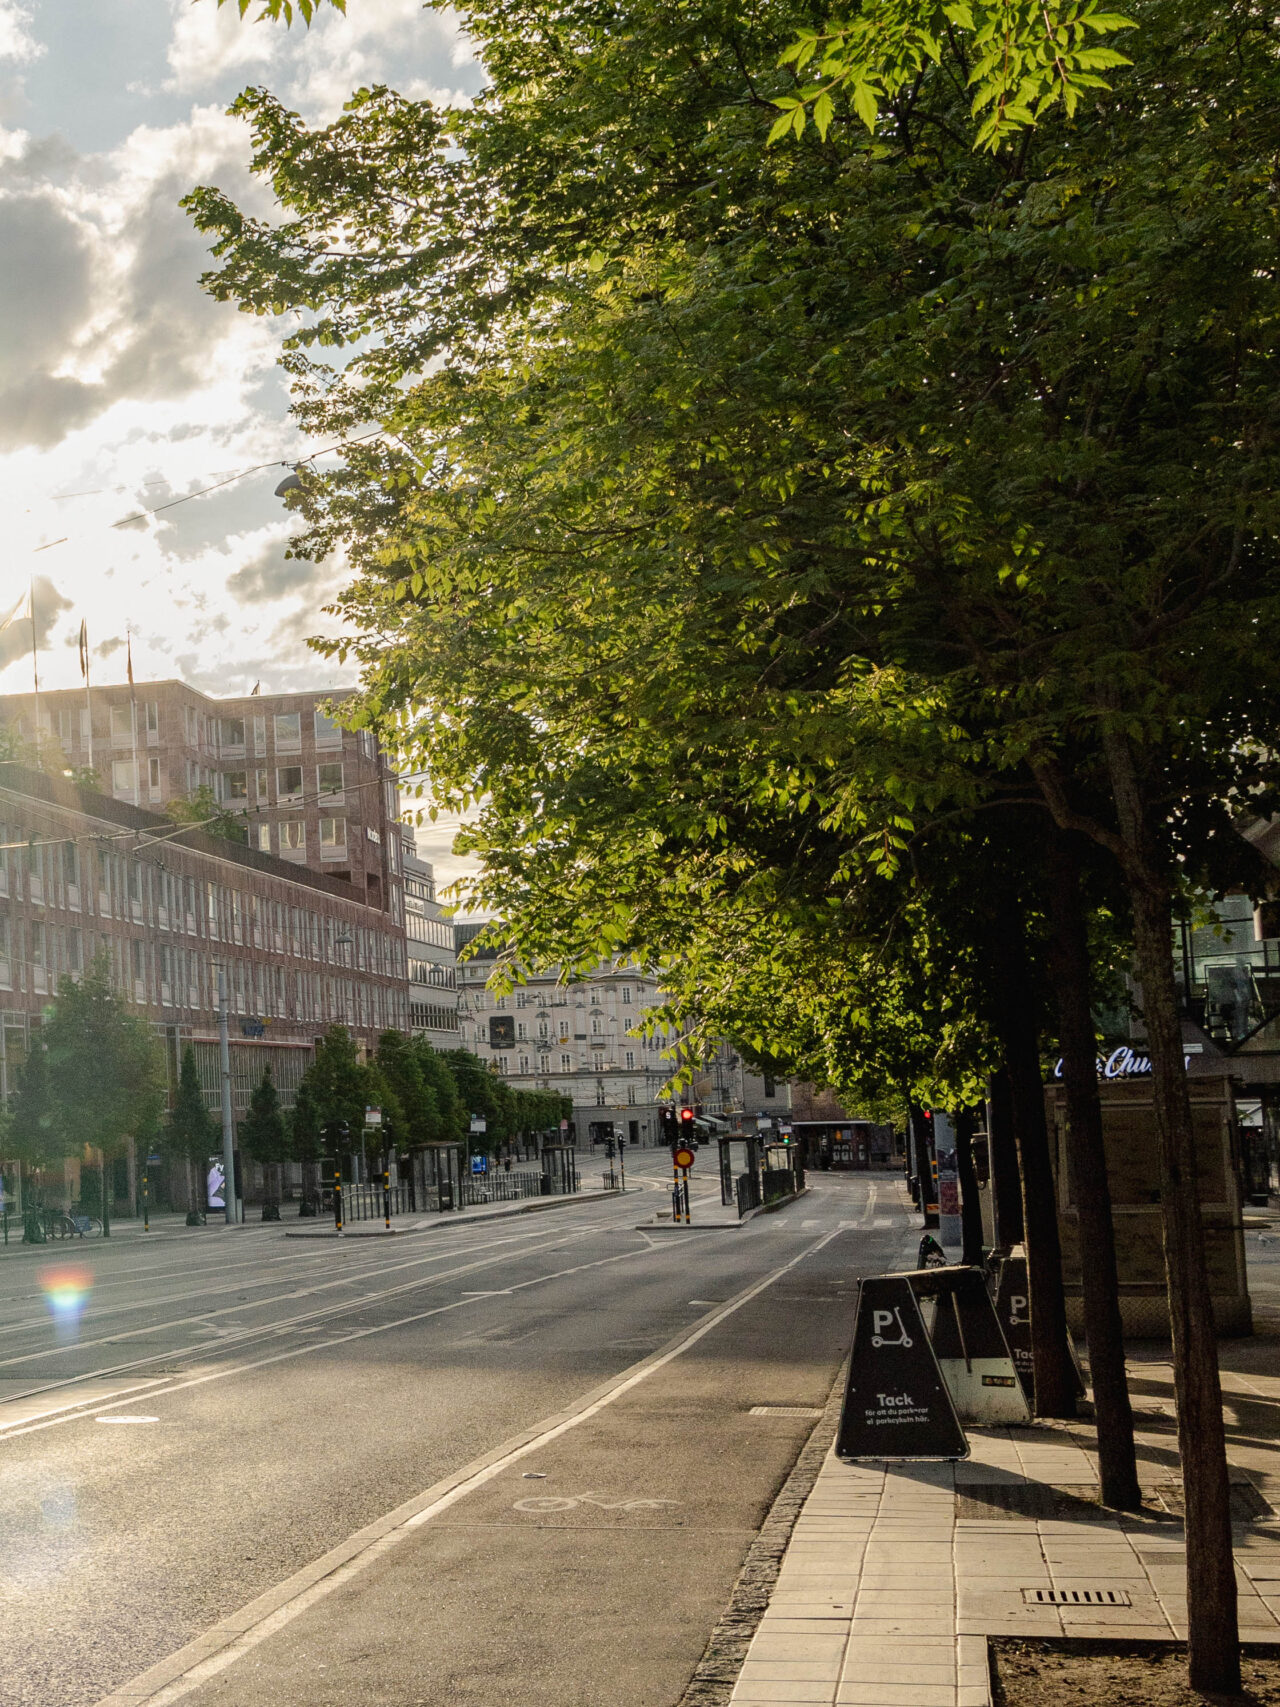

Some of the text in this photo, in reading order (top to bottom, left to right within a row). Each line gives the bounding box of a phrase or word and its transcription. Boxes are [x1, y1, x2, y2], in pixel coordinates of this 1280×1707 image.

[1010, 1295, 1027, 1315] P
[873, 1310, 893, 1334] P
[1014, 1348, 1034, 1360] Tac
[876, 1392, 914, 1407] Tack
